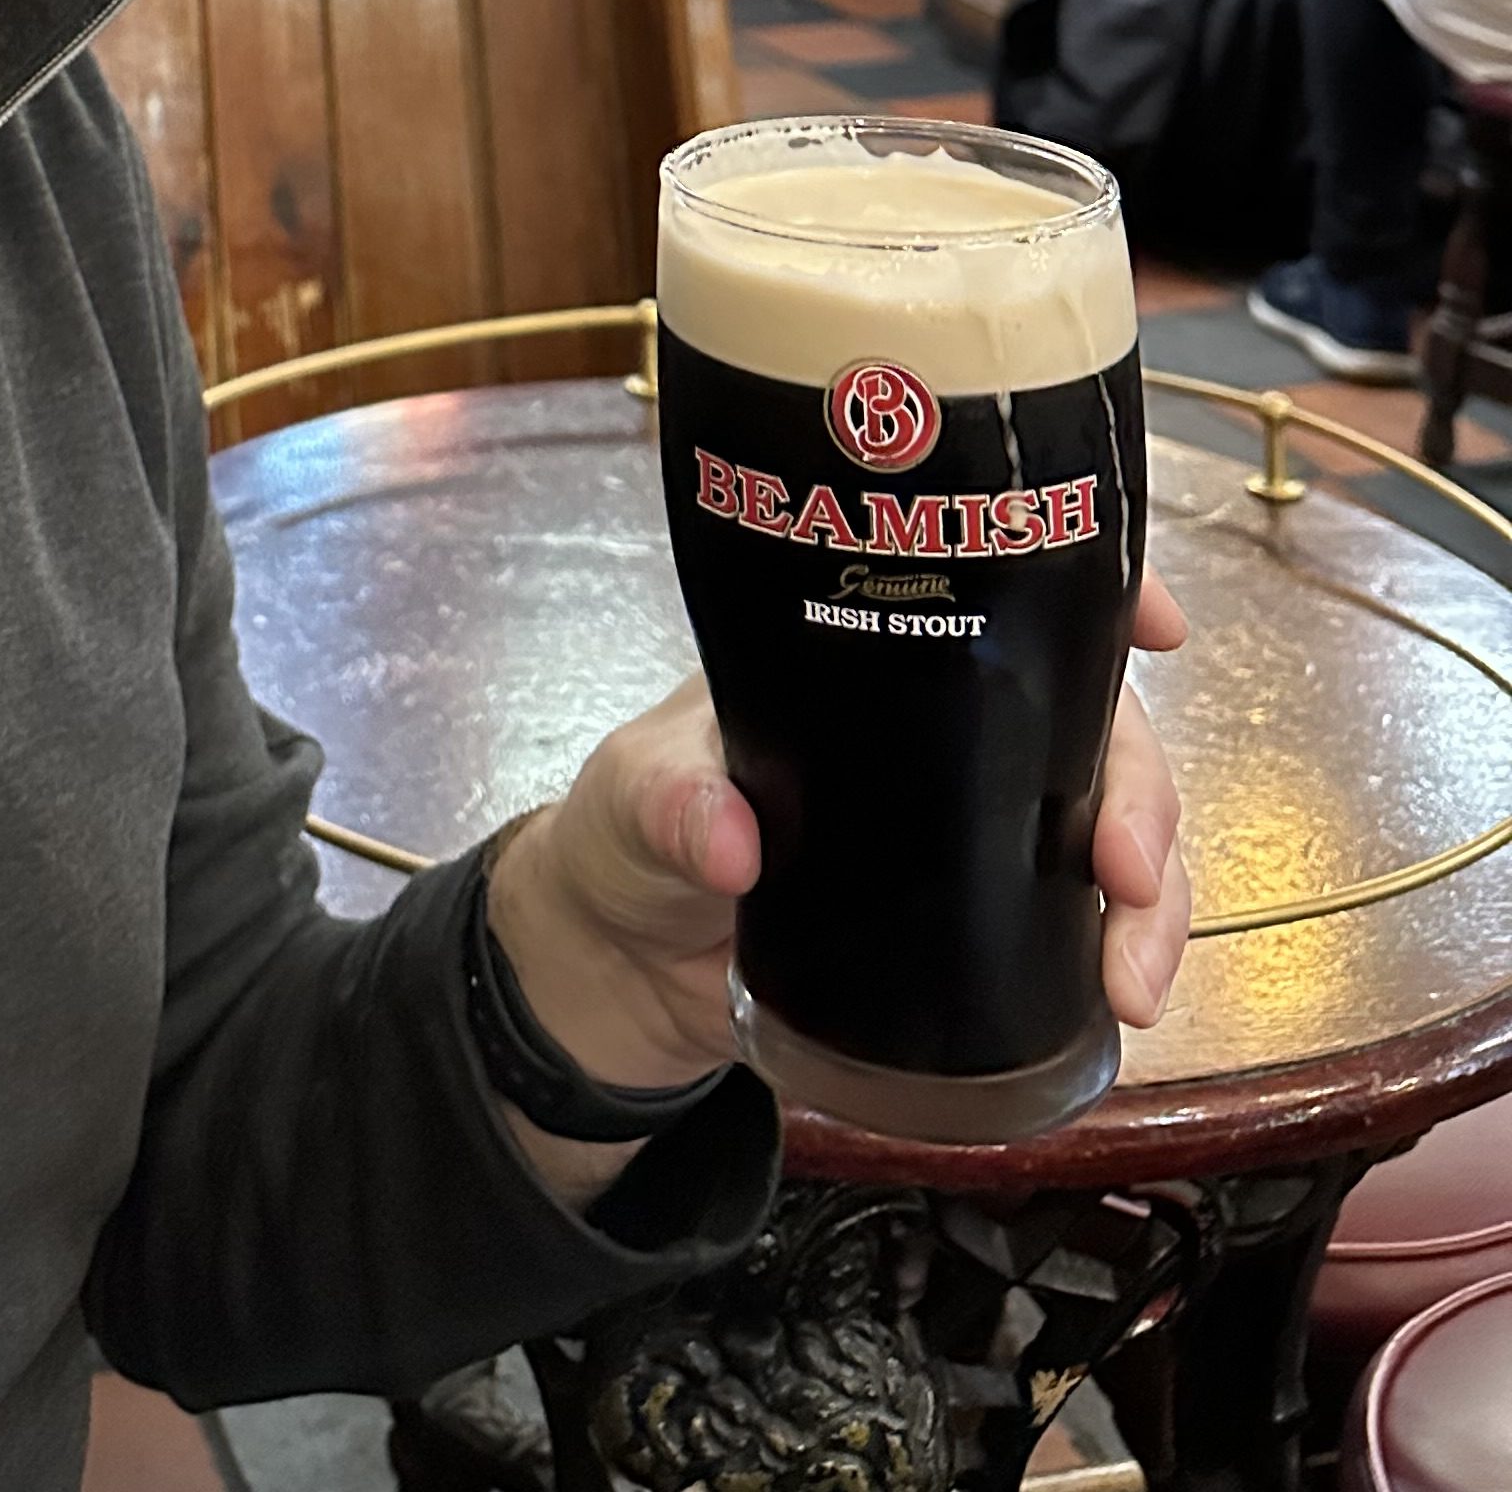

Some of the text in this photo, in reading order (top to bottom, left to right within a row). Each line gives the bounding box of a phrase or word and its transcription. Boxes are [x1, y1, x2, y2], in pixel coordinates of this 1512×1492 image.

[695, 446, 1100, 557] BEAMISH
[828, 563, 957, 604] Genuine
[803, 599, 987, 638] IRISH STOUT
